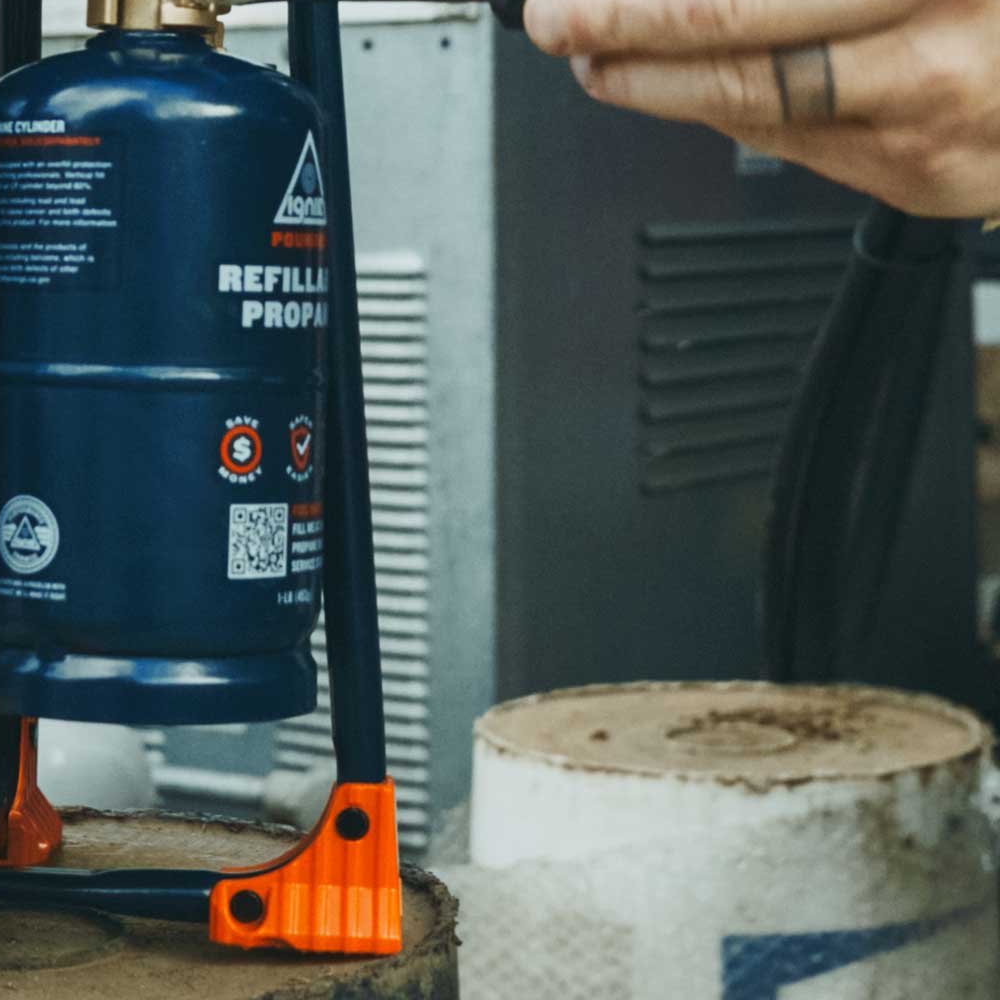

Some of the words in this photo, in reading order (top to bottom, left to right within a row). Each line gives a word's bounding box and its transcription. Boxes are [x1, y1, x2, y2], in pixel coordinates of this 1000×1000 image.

[14, 119, 66, 134] CYLINDER
[225, 416, 259, 430] SAVE
[218, 466, 262, 483] MONEY
